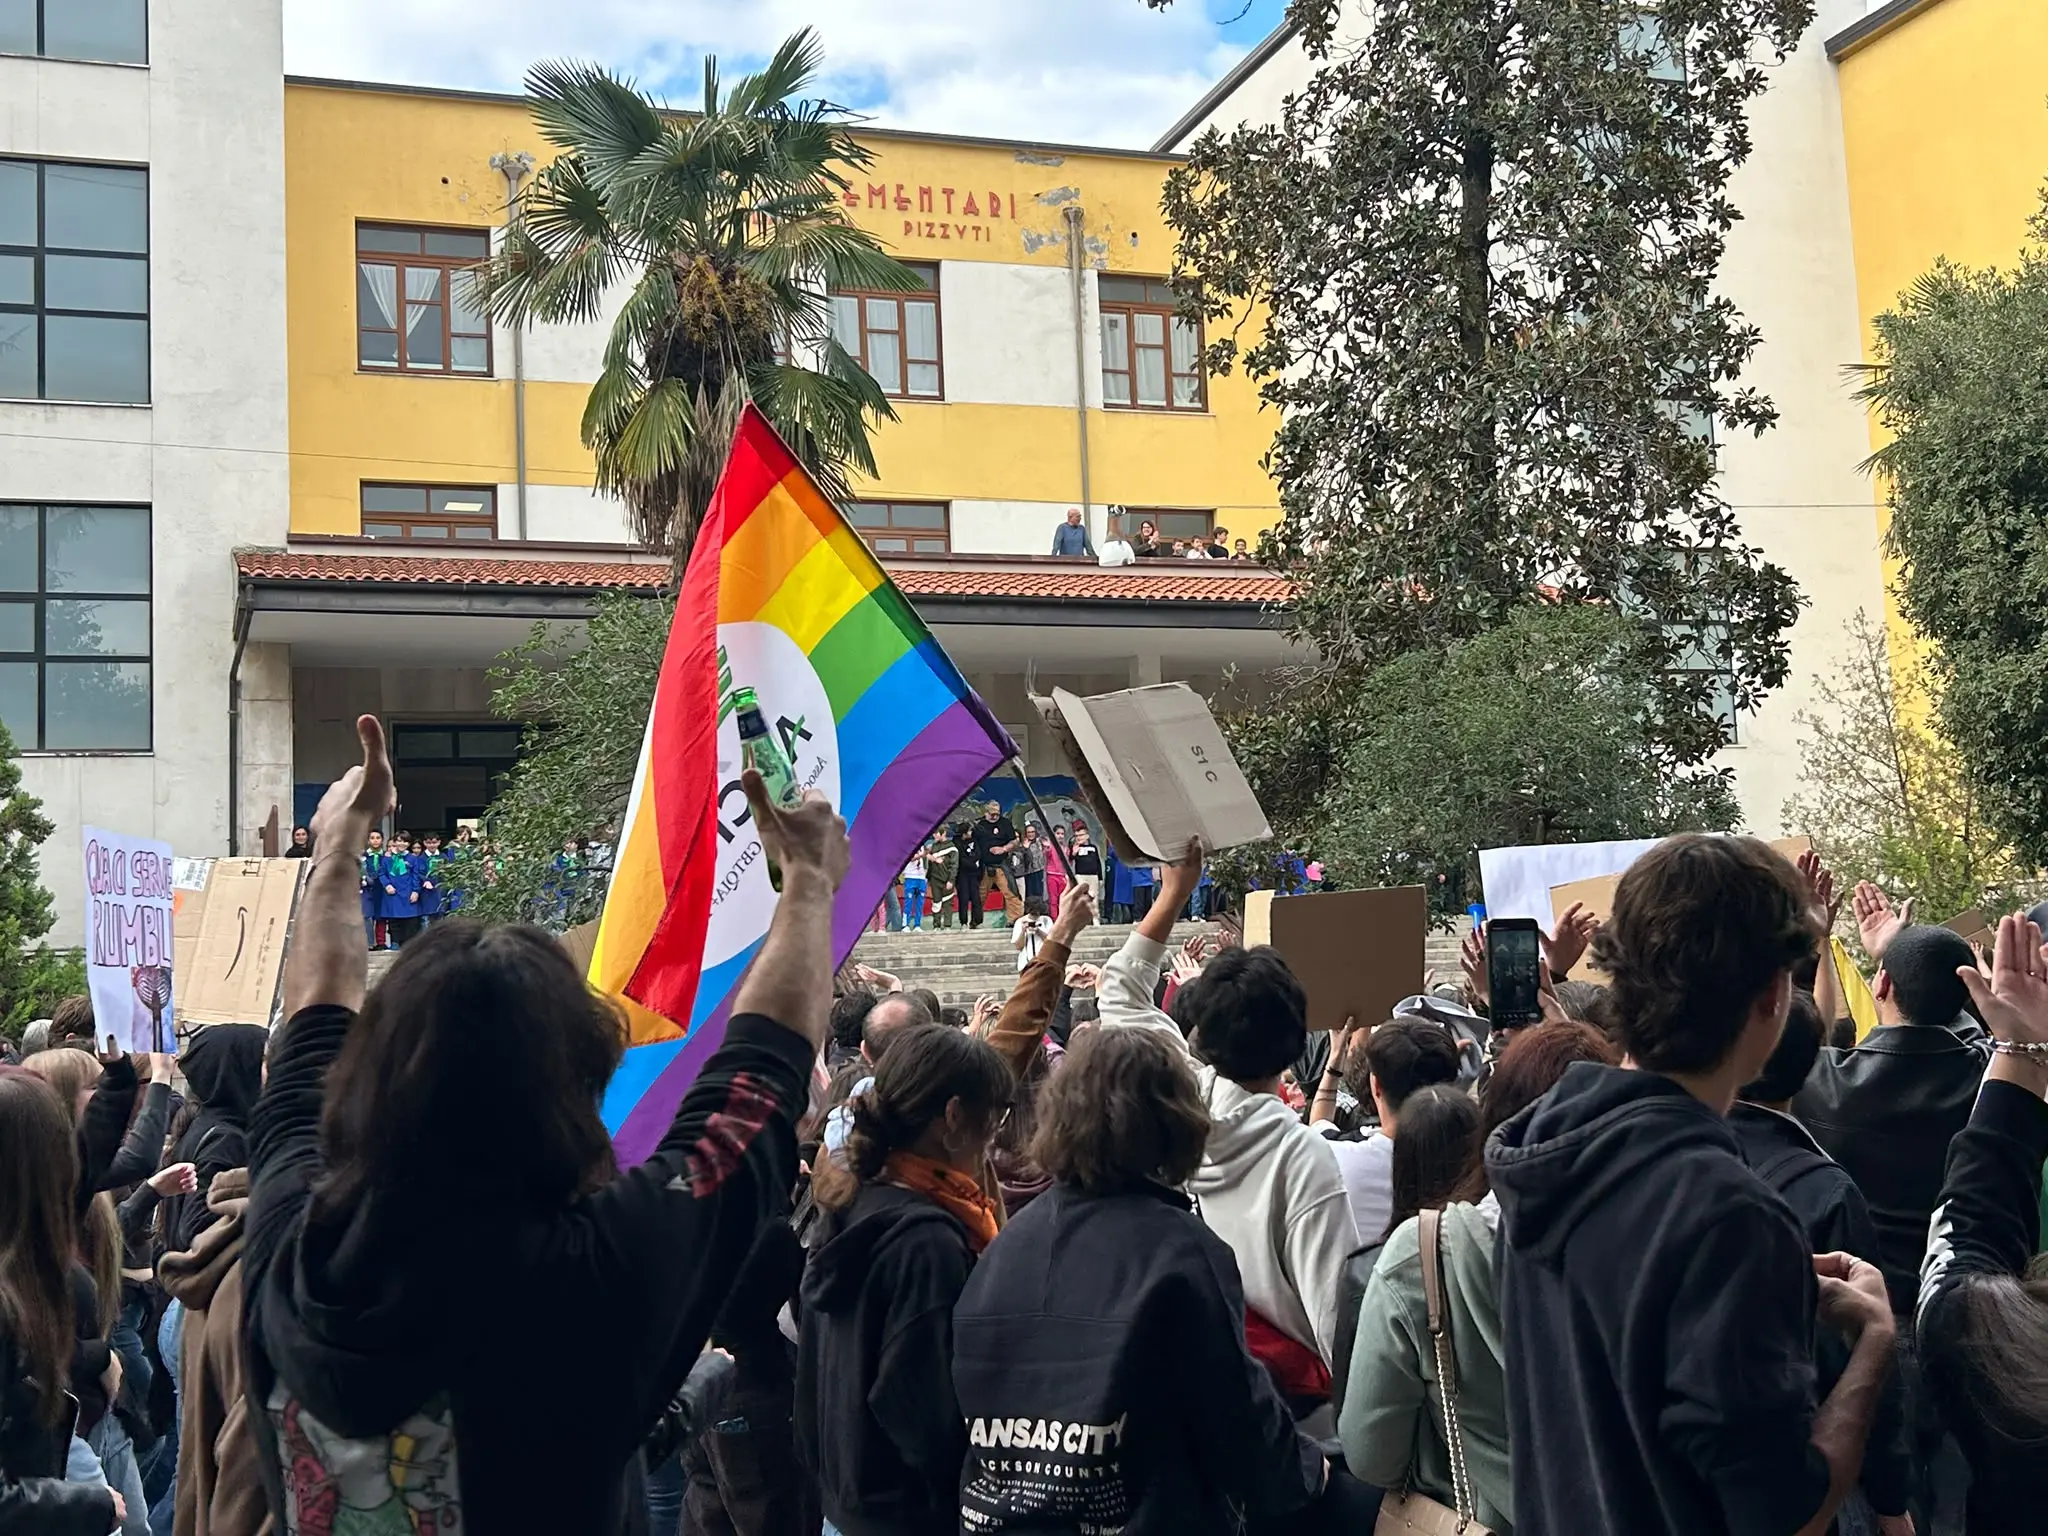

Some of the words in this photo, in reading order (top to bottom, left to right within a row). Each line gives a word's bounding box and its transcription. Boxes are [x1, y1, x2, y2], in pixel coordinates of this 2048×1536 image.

[842, 180, 1016, 219] EMENTARI
[93, 900, 174, 972] RUMBL
[965, 1418, 1063, 1451] ANSAS
[1063, 1411, 1128, 1455] CITY
[980, 1458, 1041, 1475] CKSON
[1044, 1461, 1120, 1479] COUNTY
